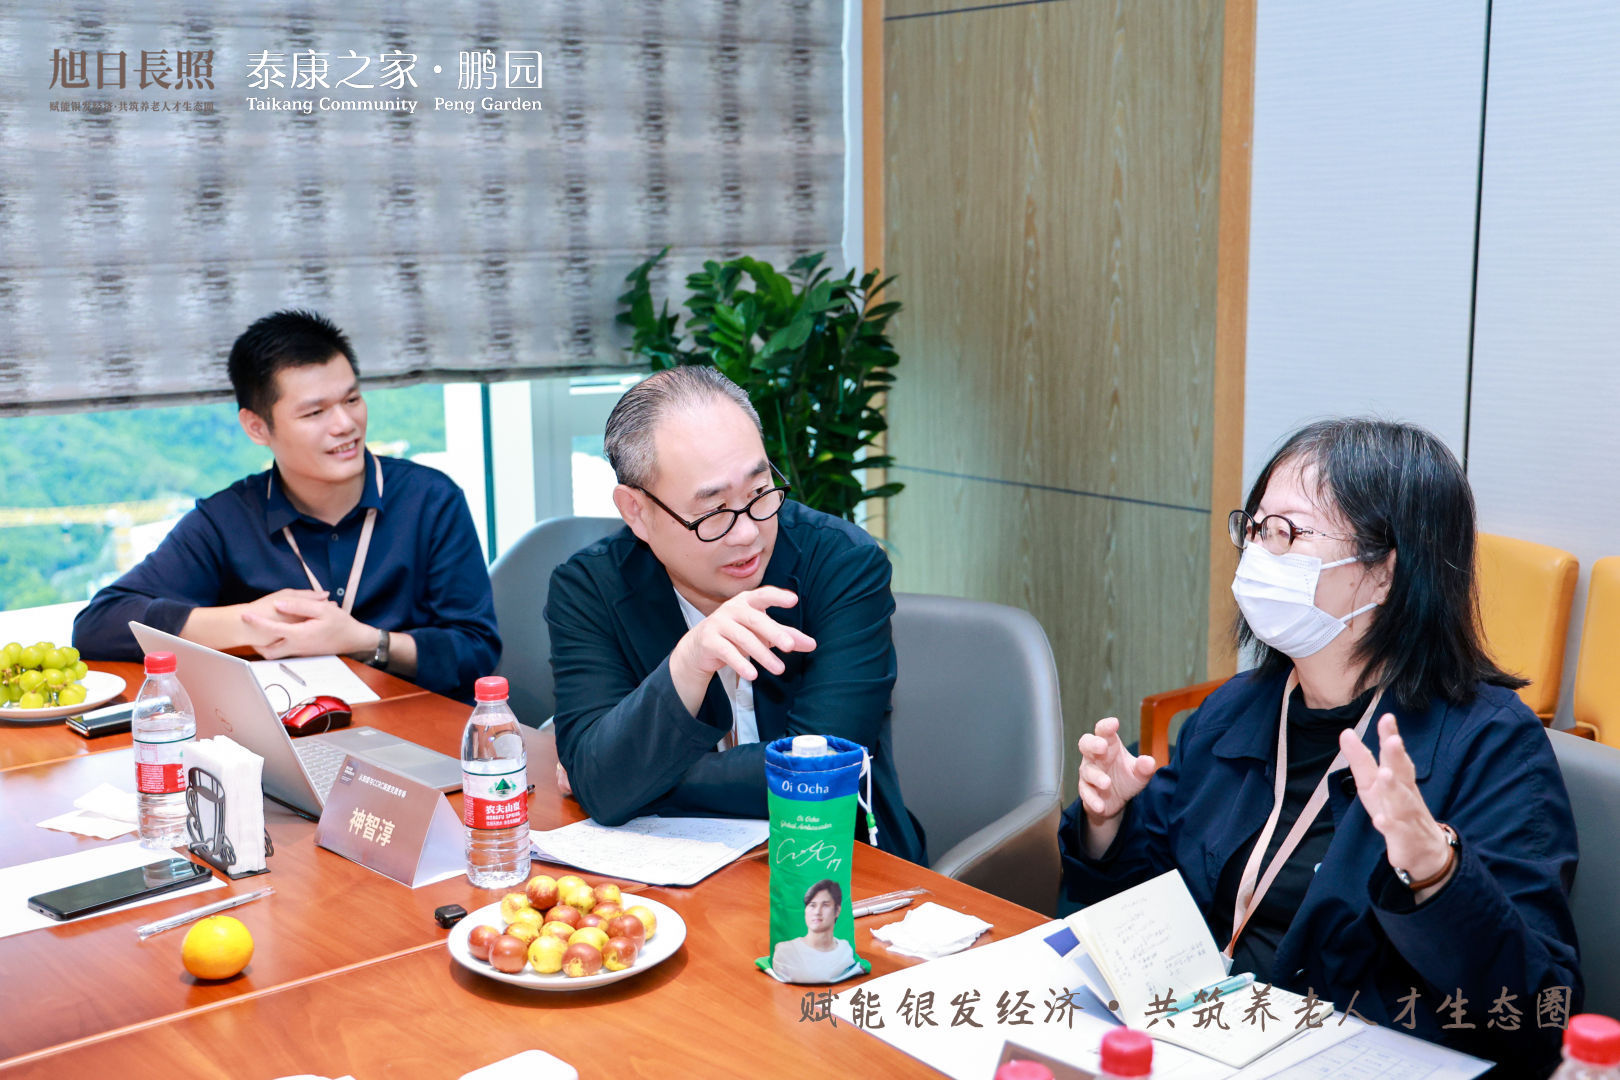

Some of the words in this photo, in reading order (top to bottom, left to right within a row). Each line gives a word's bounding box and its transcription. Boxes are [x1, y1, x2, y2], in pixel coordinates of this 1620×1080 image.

[797, 782, 830, 794] Ocha
[348, 807, 396, 847] 神智淳
